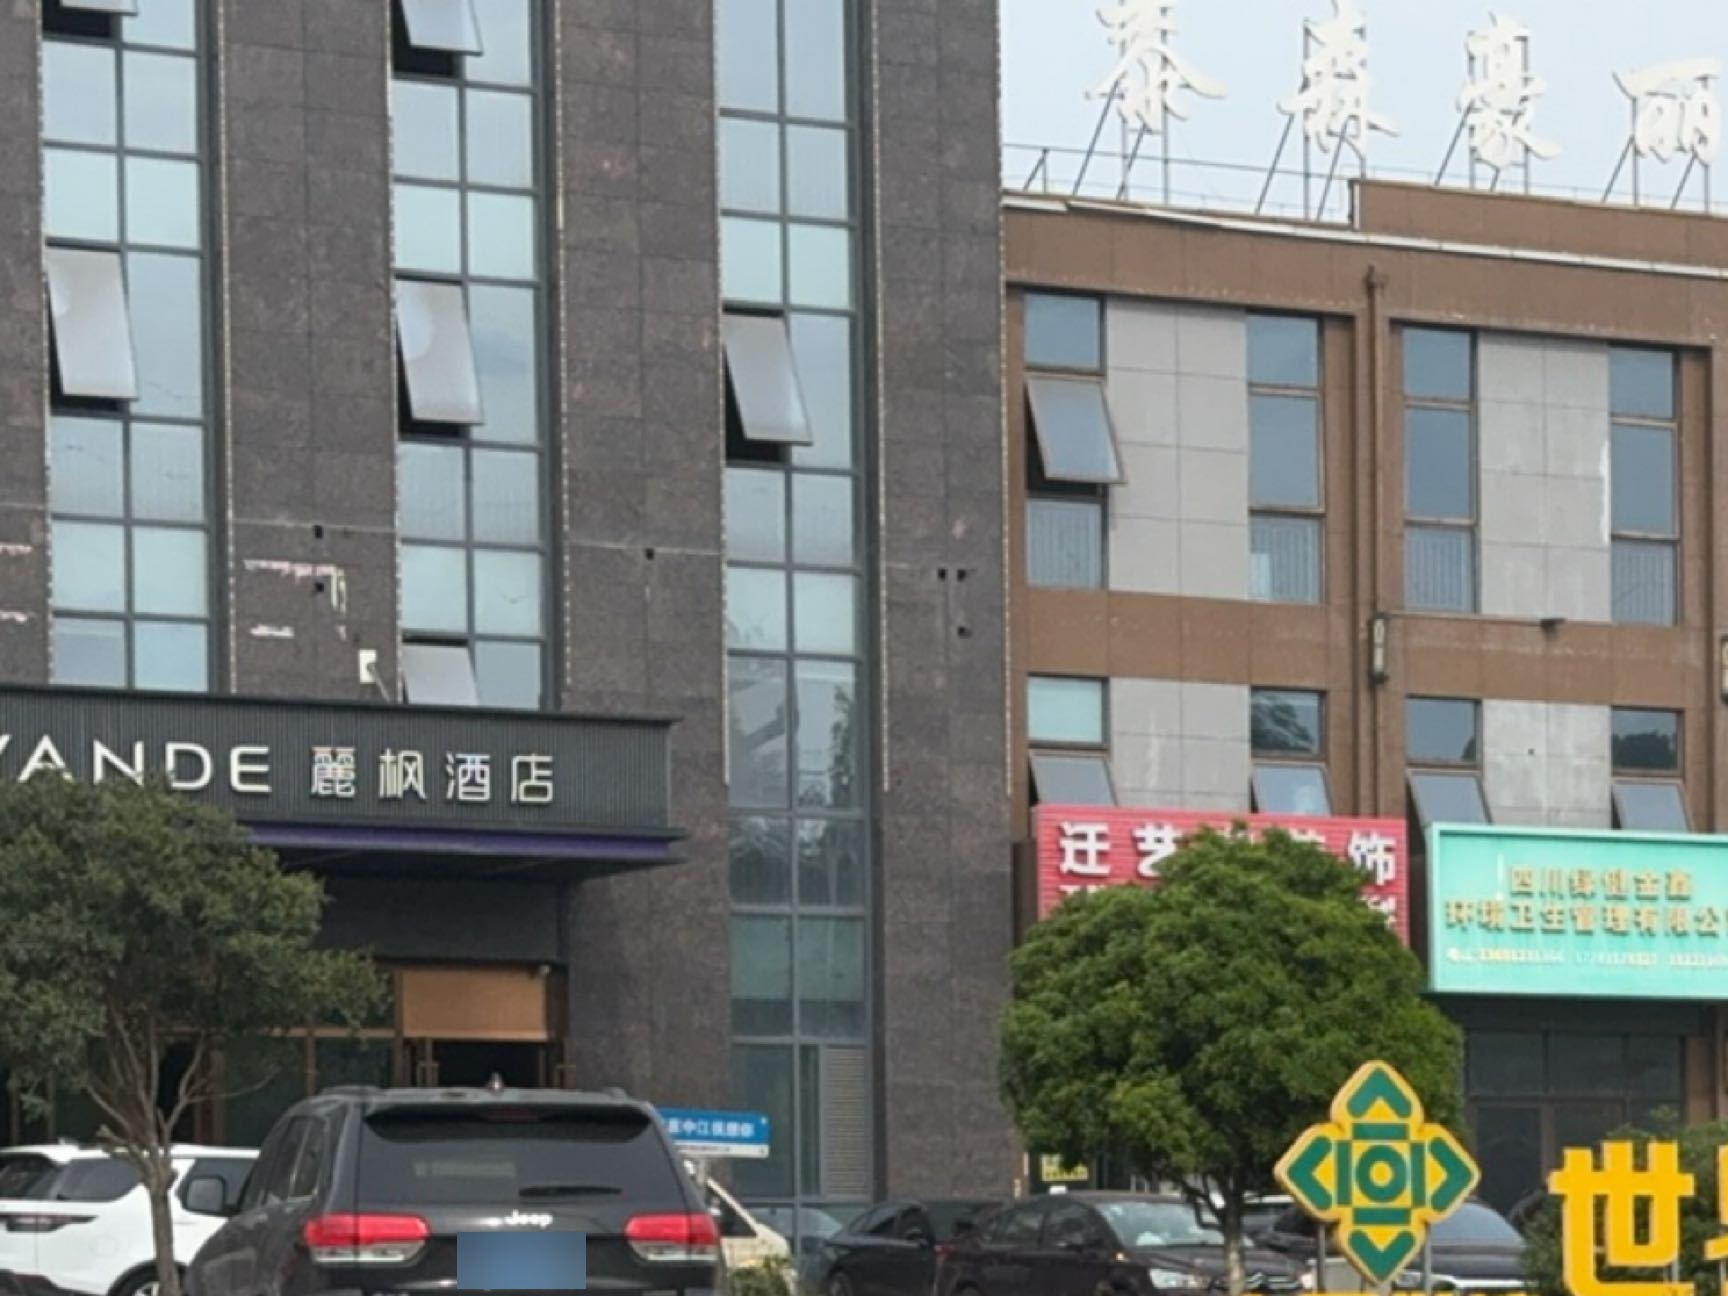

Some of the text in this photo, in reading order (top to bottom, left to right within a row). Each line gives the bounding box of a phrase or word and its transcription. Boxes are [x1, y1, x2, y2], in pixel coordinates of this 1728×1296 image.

[0, 734, 555, 805] ANDE 麗枫酒店
[504, 1209, 554, 1228] Jeep
